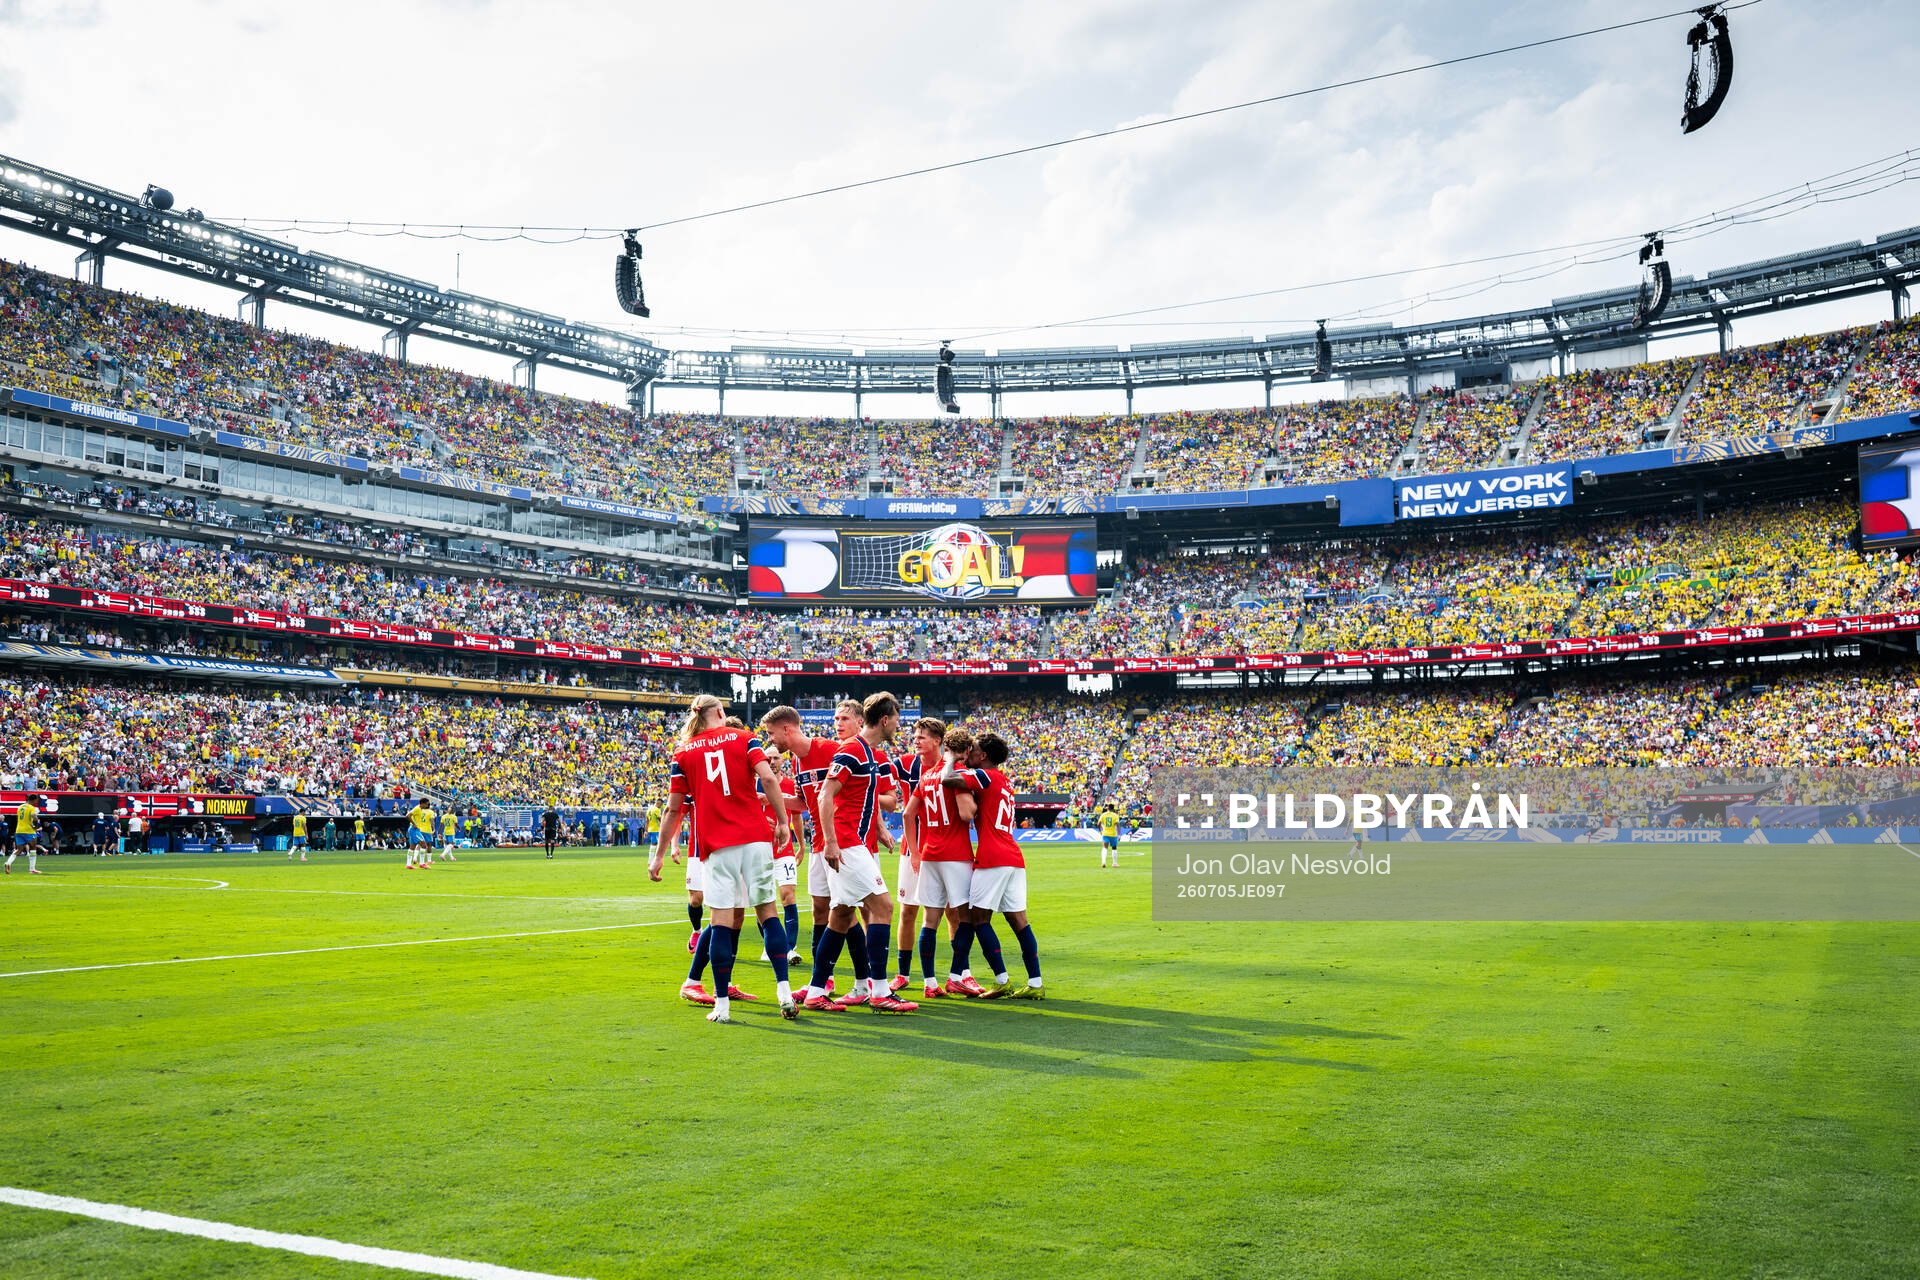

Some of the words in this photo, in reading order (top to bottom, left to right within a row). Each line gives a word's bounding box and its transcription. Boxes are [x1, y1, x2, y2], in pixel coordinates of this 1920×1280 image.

[70, 401, 138, 426] #FIFAWorldCup
[1402, 481, 1471, 501] NEW
[1478, 471, 1567, 494] YORK
[567, 498, 588, 507] NEW
[590, 501, 615, 512] YORK
[617, 506, 638, 515] NEW
[639, 510, 673, 521] JERSEY
[888, 502, 957, 515] #FIFAWorldCup
[1402, 502, 1459, 518] NEW
[1464, 491, 1567, 513] JERSEY
[898, 544, 1025, 588] GOAL!
[169, 658, 202, 667] FIFA
[205, 660, 251, 671] WORLD
[708, 733, 738, 746] HAALAND
[704, 749, 731, 796] 9
[206, 799, 247, 815] NORWAY
[924, 783, 950, 827] 21
[19, 808, 25, 820] 3
[1018, 830, 1067, 840] F50
[1163, 829, 1233, 840] PREDATOR
[1446, 829, 1508, 841] F50
[1631, 830, 1722, 842] PREDATOR
[784, 863, 795, 876] 14
